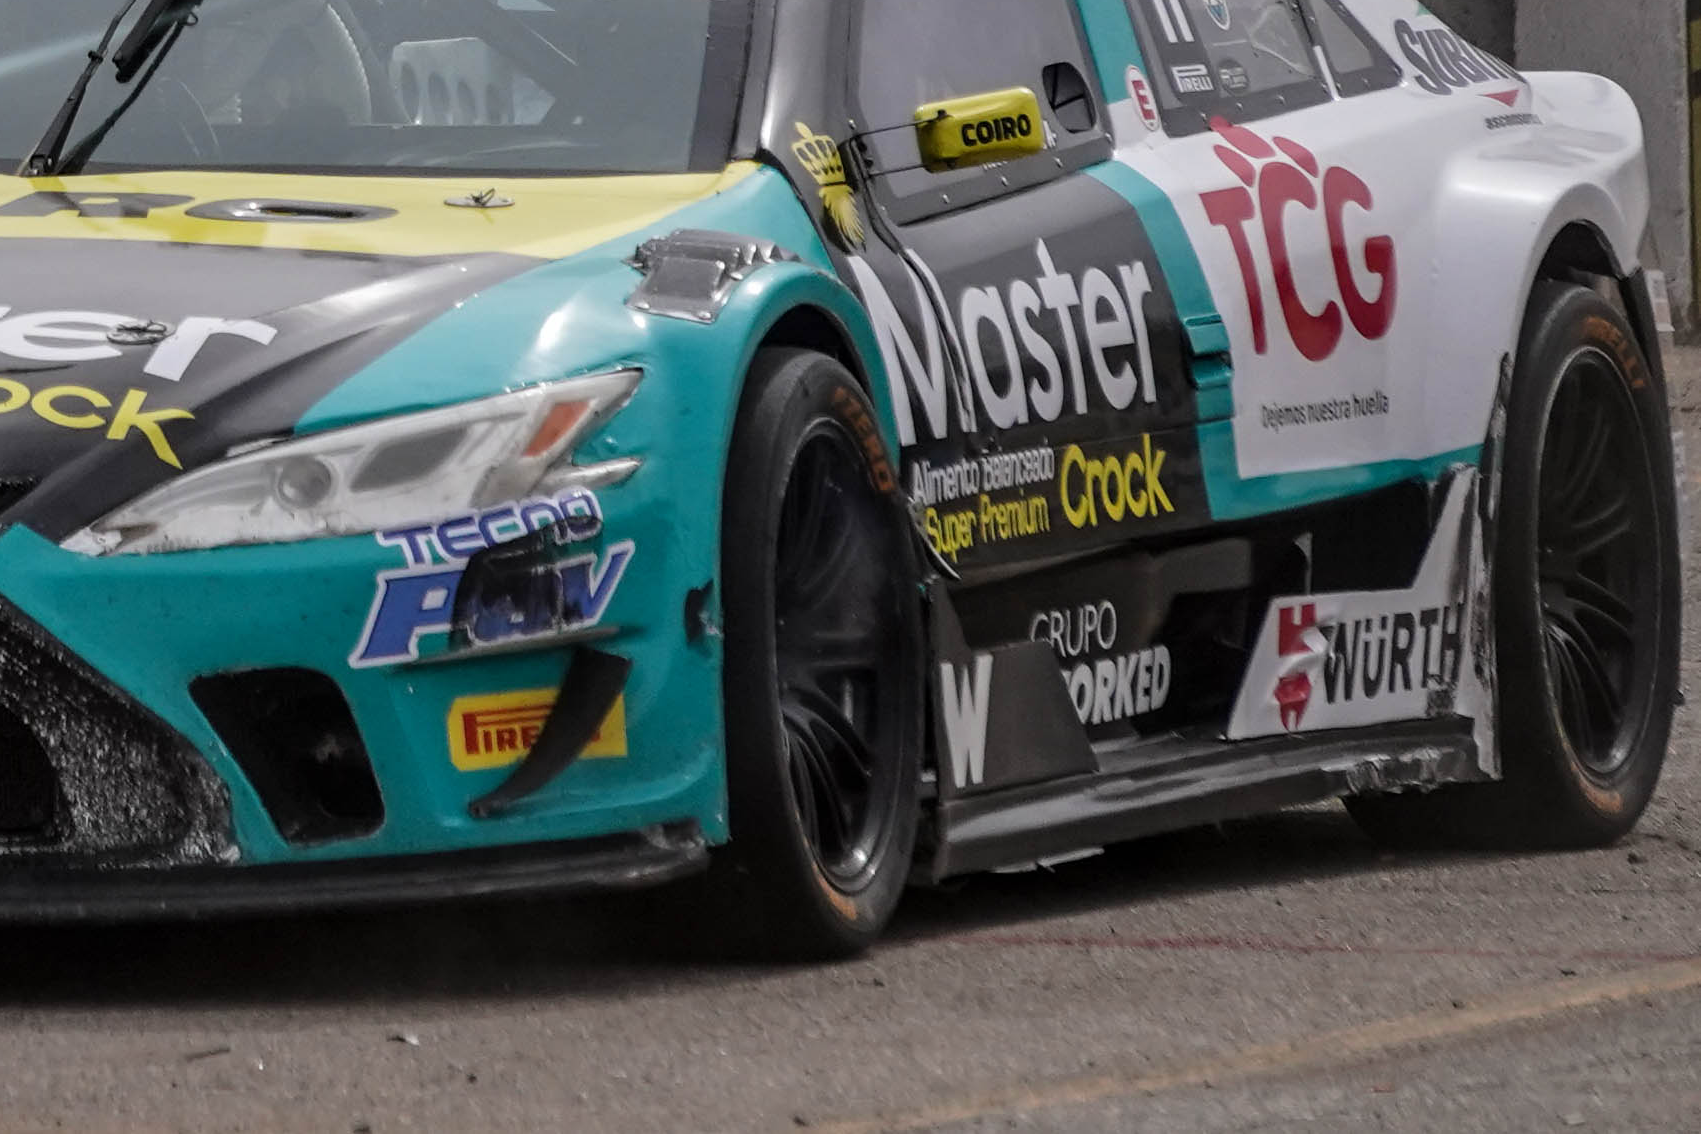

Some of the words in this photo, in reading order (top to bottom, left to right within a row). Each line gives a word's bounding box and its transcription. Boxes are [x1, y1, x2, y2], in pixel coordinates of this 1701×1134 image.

[960, 112, 1032, 147] COIRO
[1198, 161, 1398, 362] TCG
[846, 237, 1158, 447] Master
[911, 458, 981, 507] Alimento
[1060, 432, 1175, 529] Crock
[924, 506, 977, 564] Super
[979, 487, 1051, 543] Premium
[939, 653, 994, 789] W
[1060, 644, 1172, 725] ORKED
[461, 703, 603, 756] PIRE
